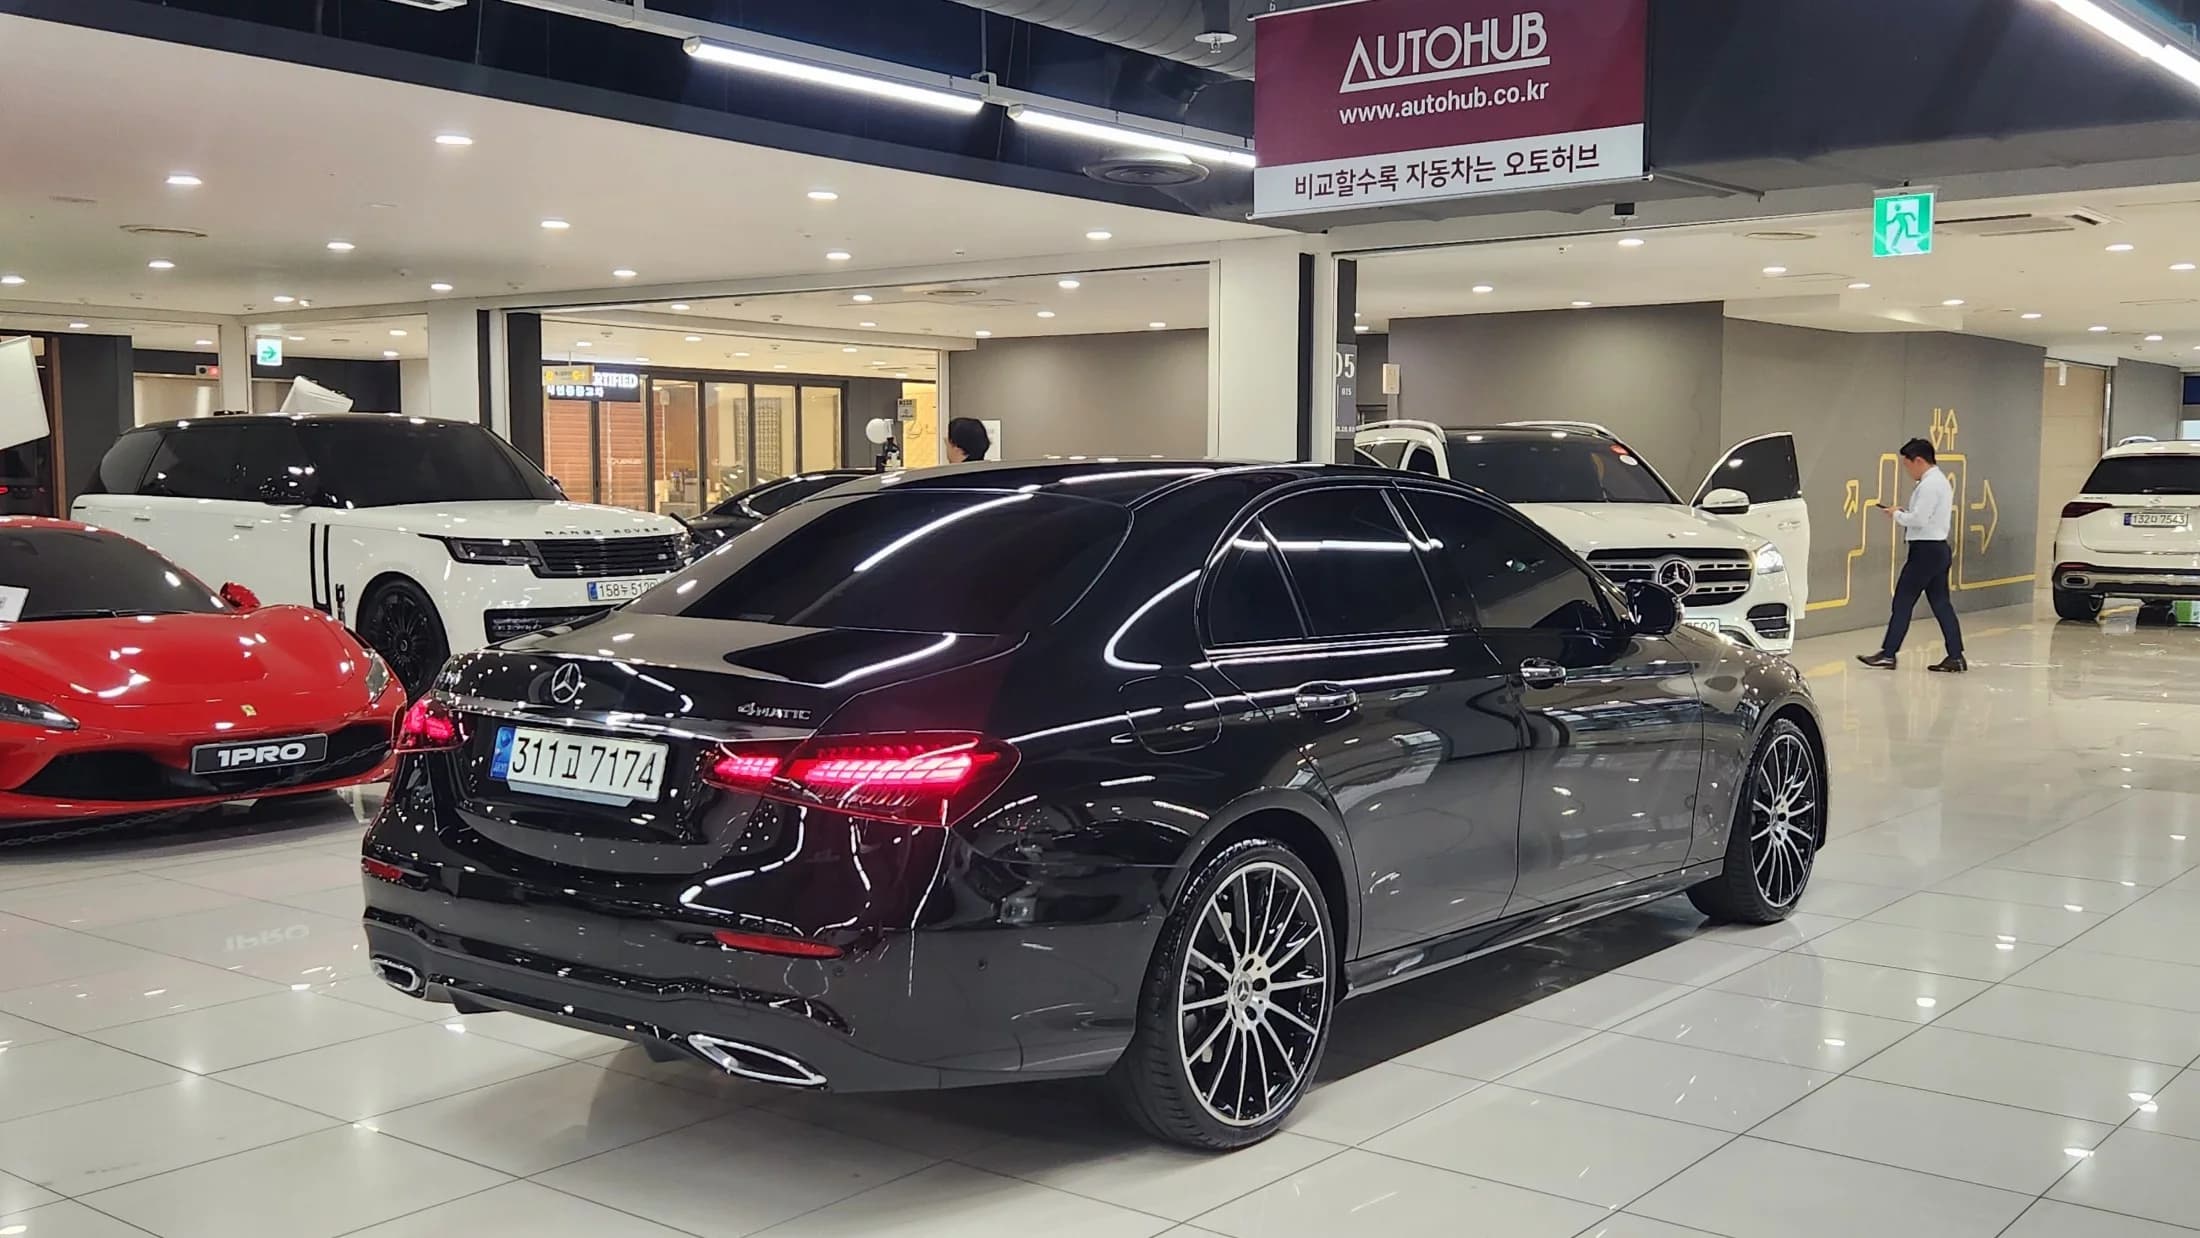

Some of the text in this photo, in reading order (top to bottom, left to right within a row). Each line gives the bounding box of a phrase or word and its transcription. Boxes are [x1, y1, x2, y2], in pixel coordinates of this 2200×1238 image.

[1339, 12, 1551, 93] AUTOHUB
[1339, 79, 1550, 125] www.autohub.co.kr
[1294, 144, 1600, 200] 비교할수록 자동차는 오토허브
[593, 372, 638, 388] RTIFIED
[737, 702, 812, 721] 4MATIC
[218, 742, 306, 767] 1PRO
